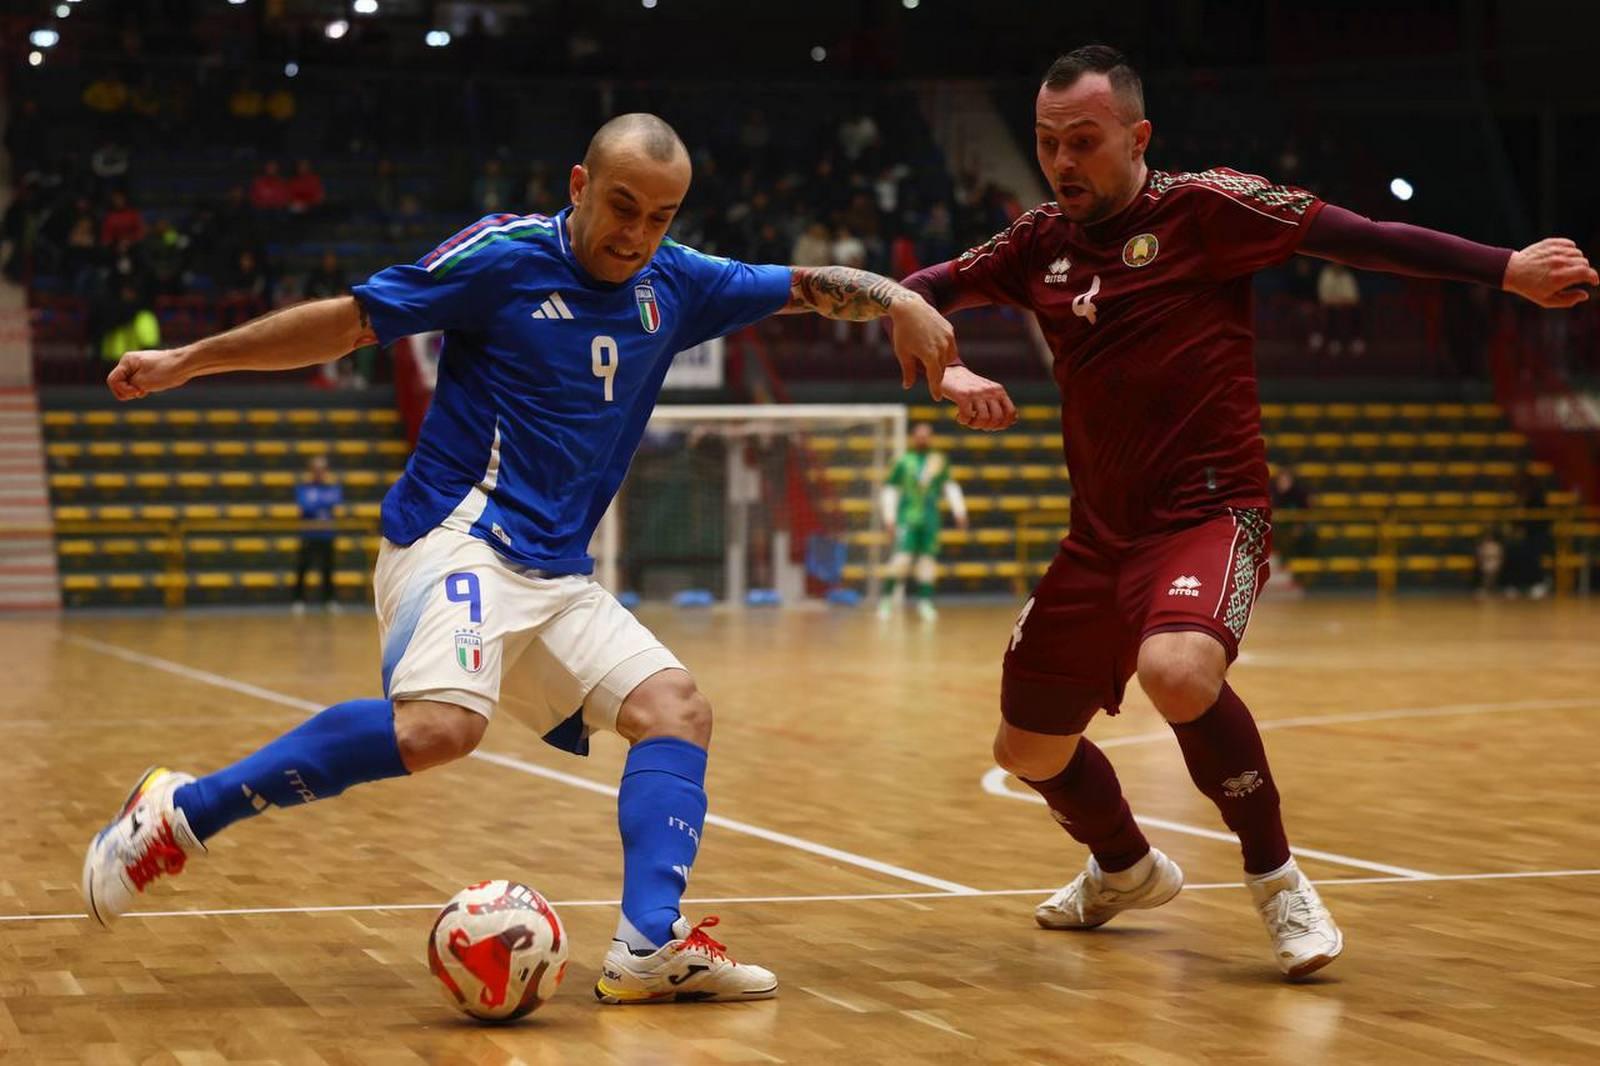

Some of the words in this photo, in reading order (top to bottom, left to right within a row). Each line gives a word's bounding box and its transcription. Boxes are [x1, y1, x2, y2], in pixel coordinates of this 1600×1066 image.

[1071, 274, 1101, 325] 4
[591, 335, 618, 401] 9
[445, 572, 481, 622] 9
